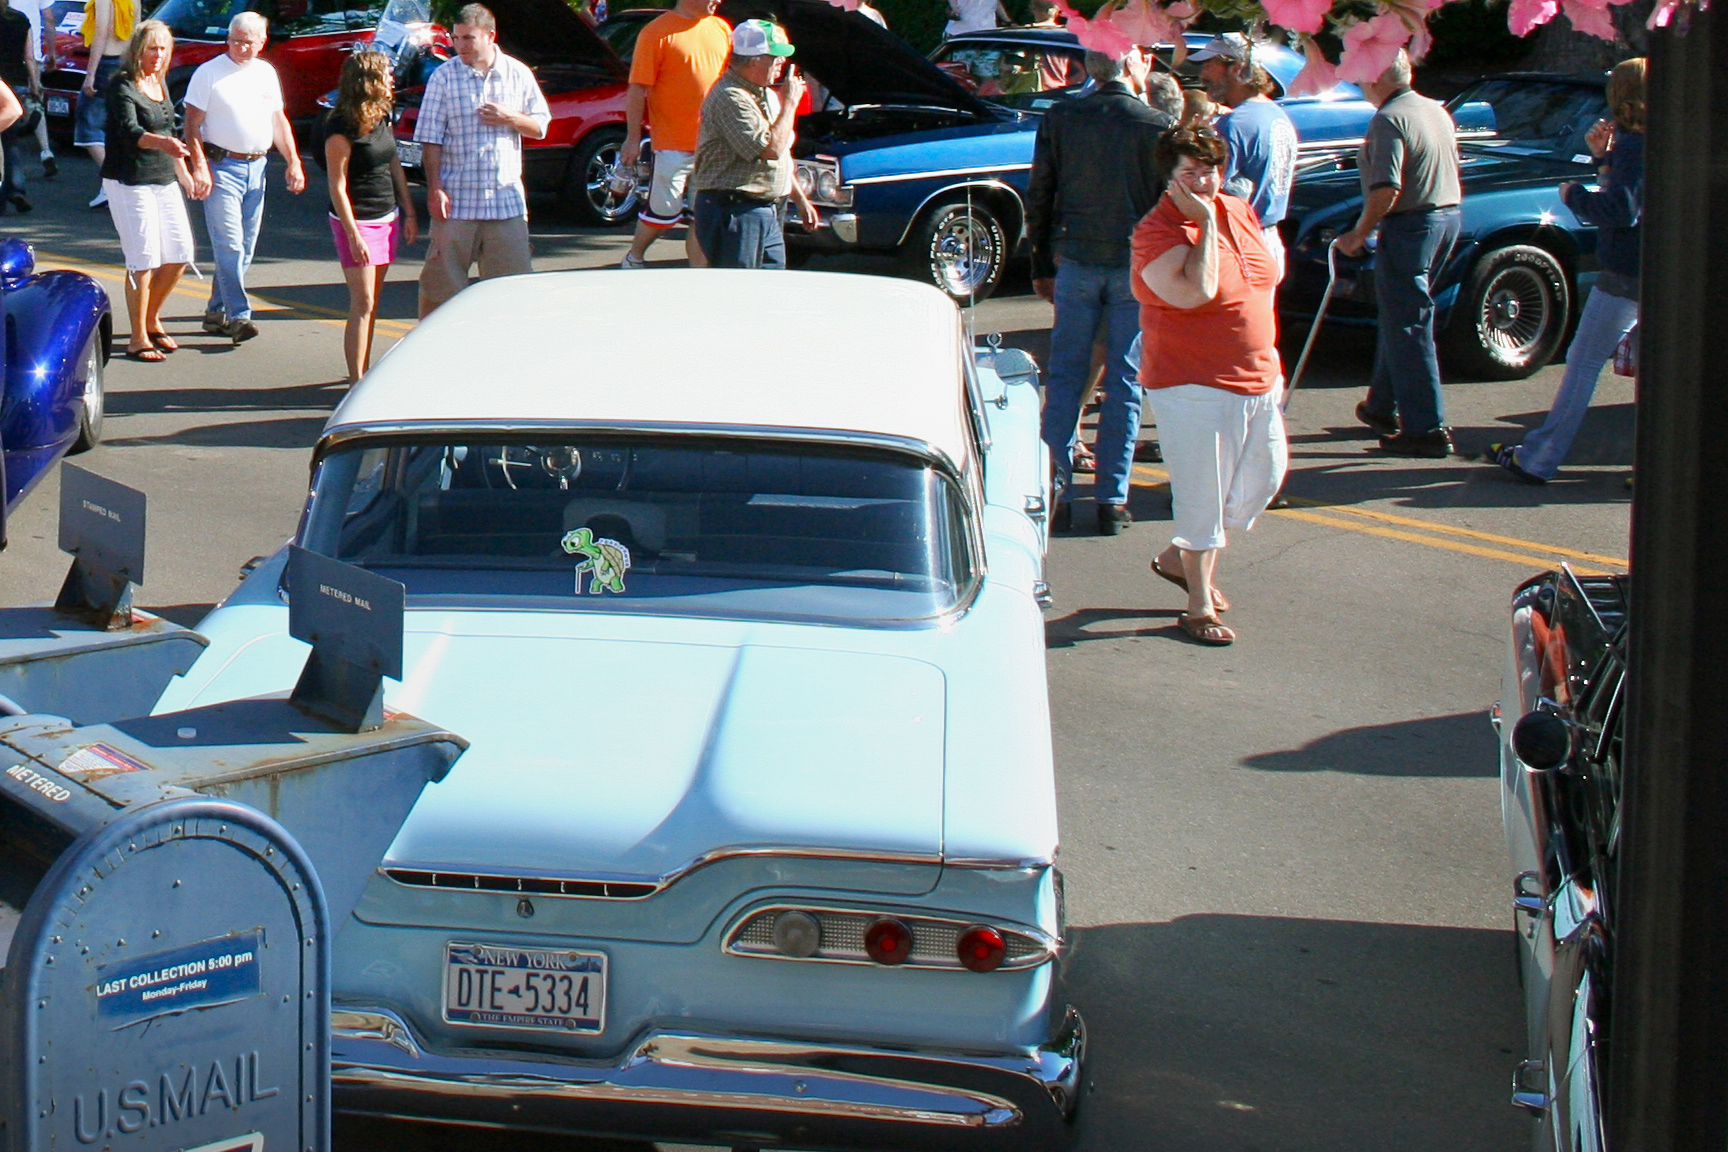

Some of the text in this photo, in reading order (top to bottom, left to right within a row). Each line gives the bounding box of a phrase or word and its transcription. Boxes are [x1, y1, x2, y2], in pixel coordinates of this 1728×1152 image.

[987, 225, 1002, 284] UNIROYAL
[1514, 253, 1562, 301] GOODYEAR
[319, 583, 372, 611] METERED MAIL
[5, 764, 71, 802] METERED
[96, 951, 253, 997] LAST COLLECTION 5:00 pm
[483, 949, 568, 970] NEW YORK
[142, 978, 208, 1001] Monday-Friday
[457, 967, 590, 1016] DTE 5334
[482, 1013, 565, 1027] THE EMPIRE STATE
